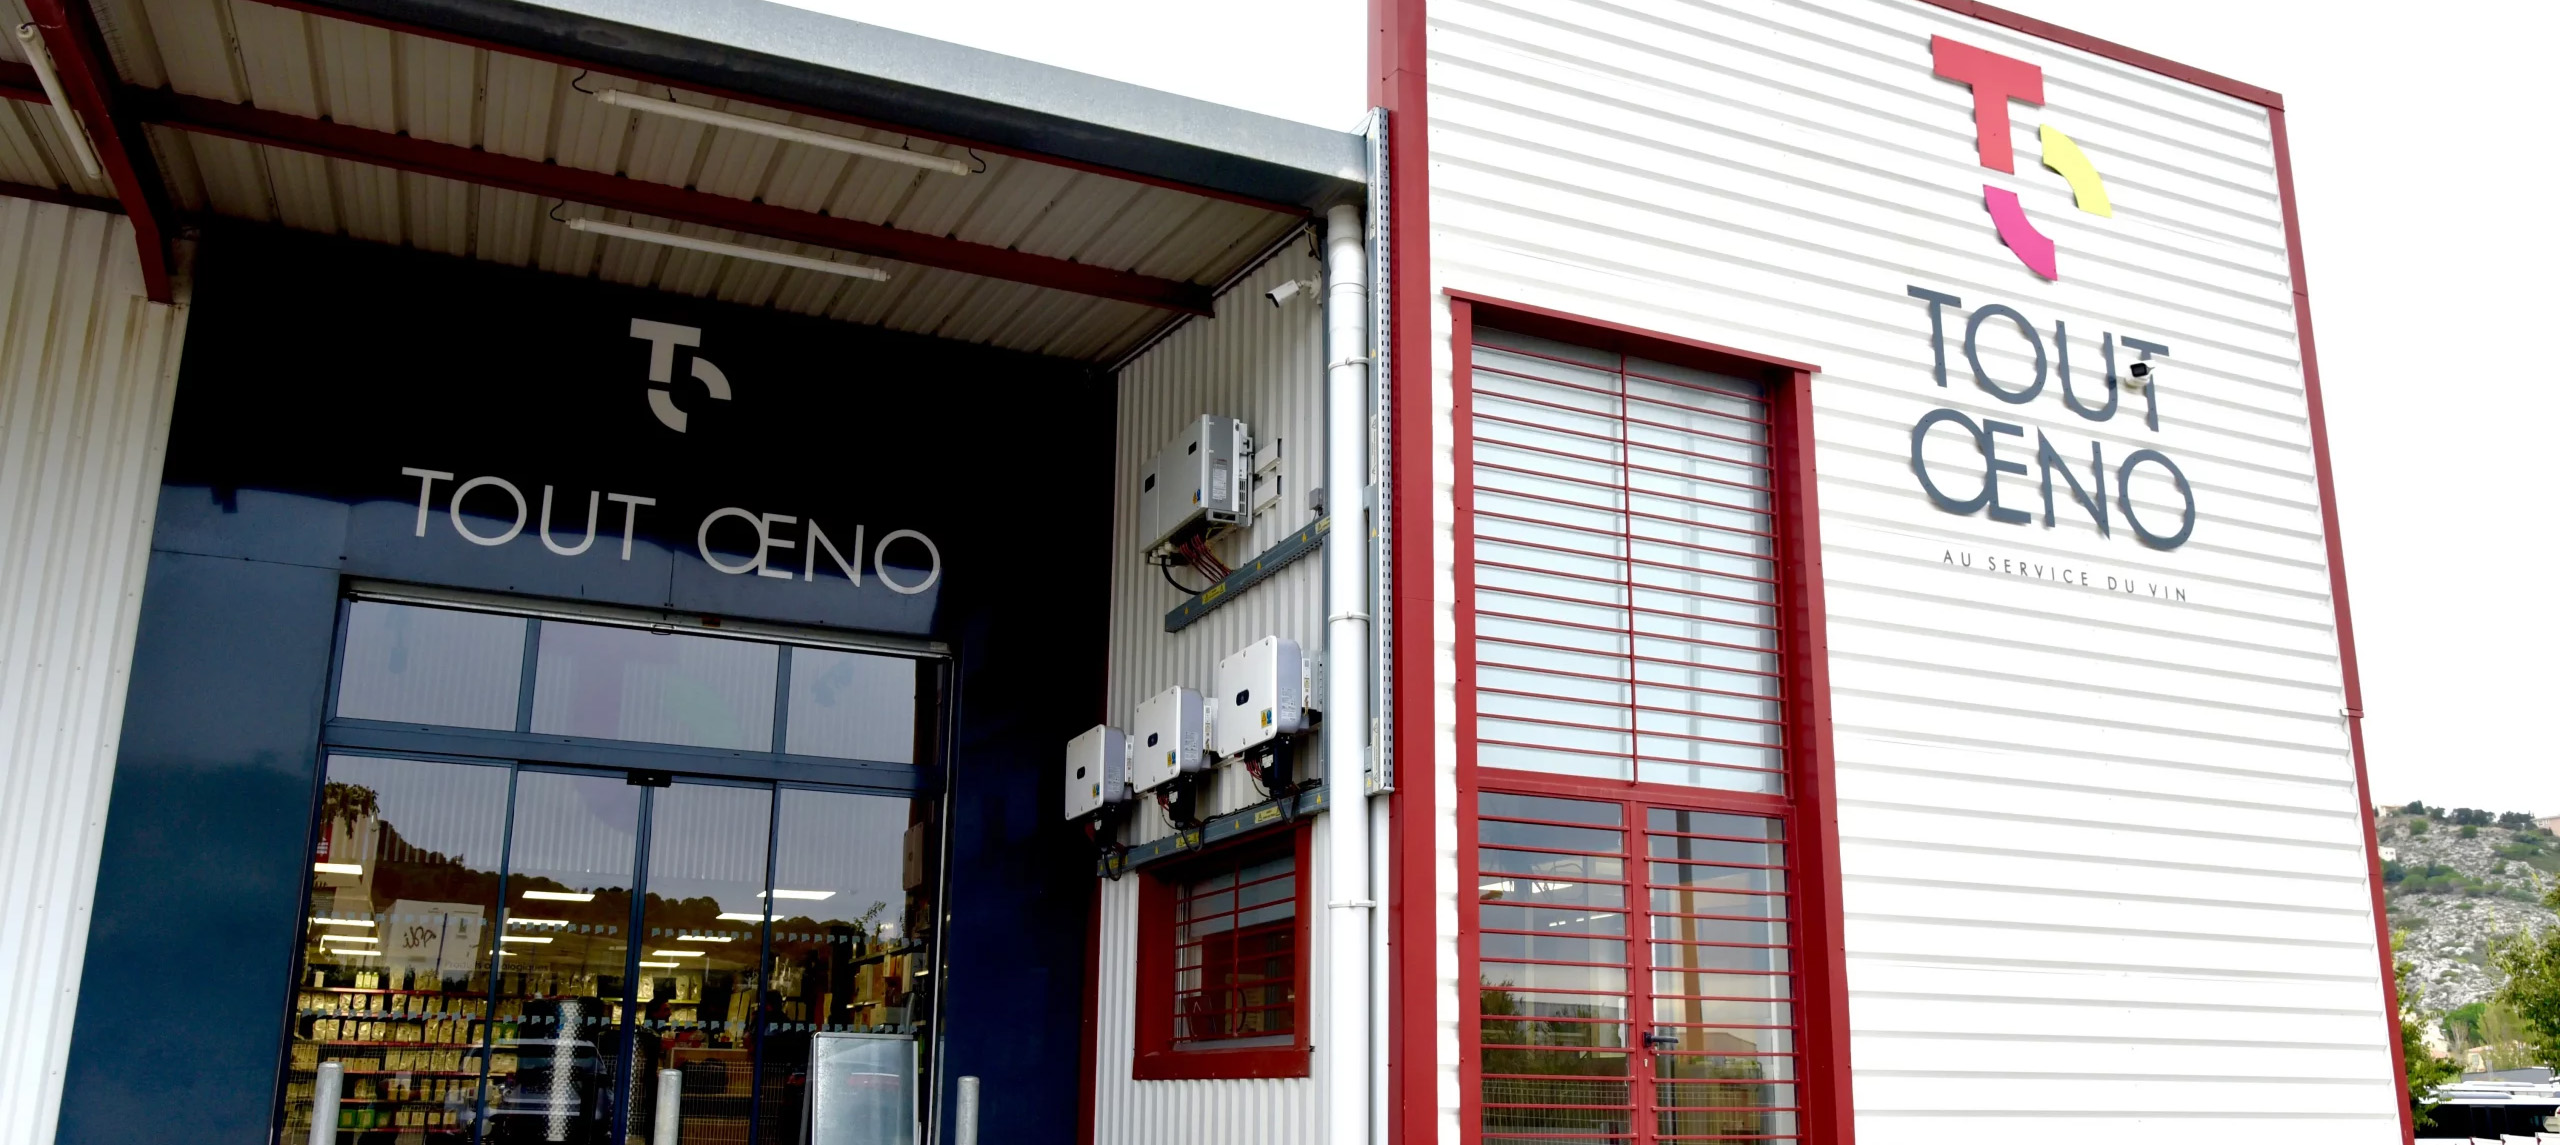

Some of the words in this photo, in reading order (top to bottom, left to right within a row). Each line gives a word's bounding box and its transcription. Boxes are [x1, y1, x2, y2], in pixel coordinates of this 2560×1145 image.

[1907, 285, 2169, 432] TOUT
[402, 466, 657, 561] TOUT
[698, 507, 941, 595] ŒNO
[1911, 408, 2196, 552] ŒNO
[1943, 549, 1972, 568] AU
[1988, 556, 2089, 587] SERVICE
[2107, 576, 2135, 594] DU
[2148, 583, 2187, 602] VIN
